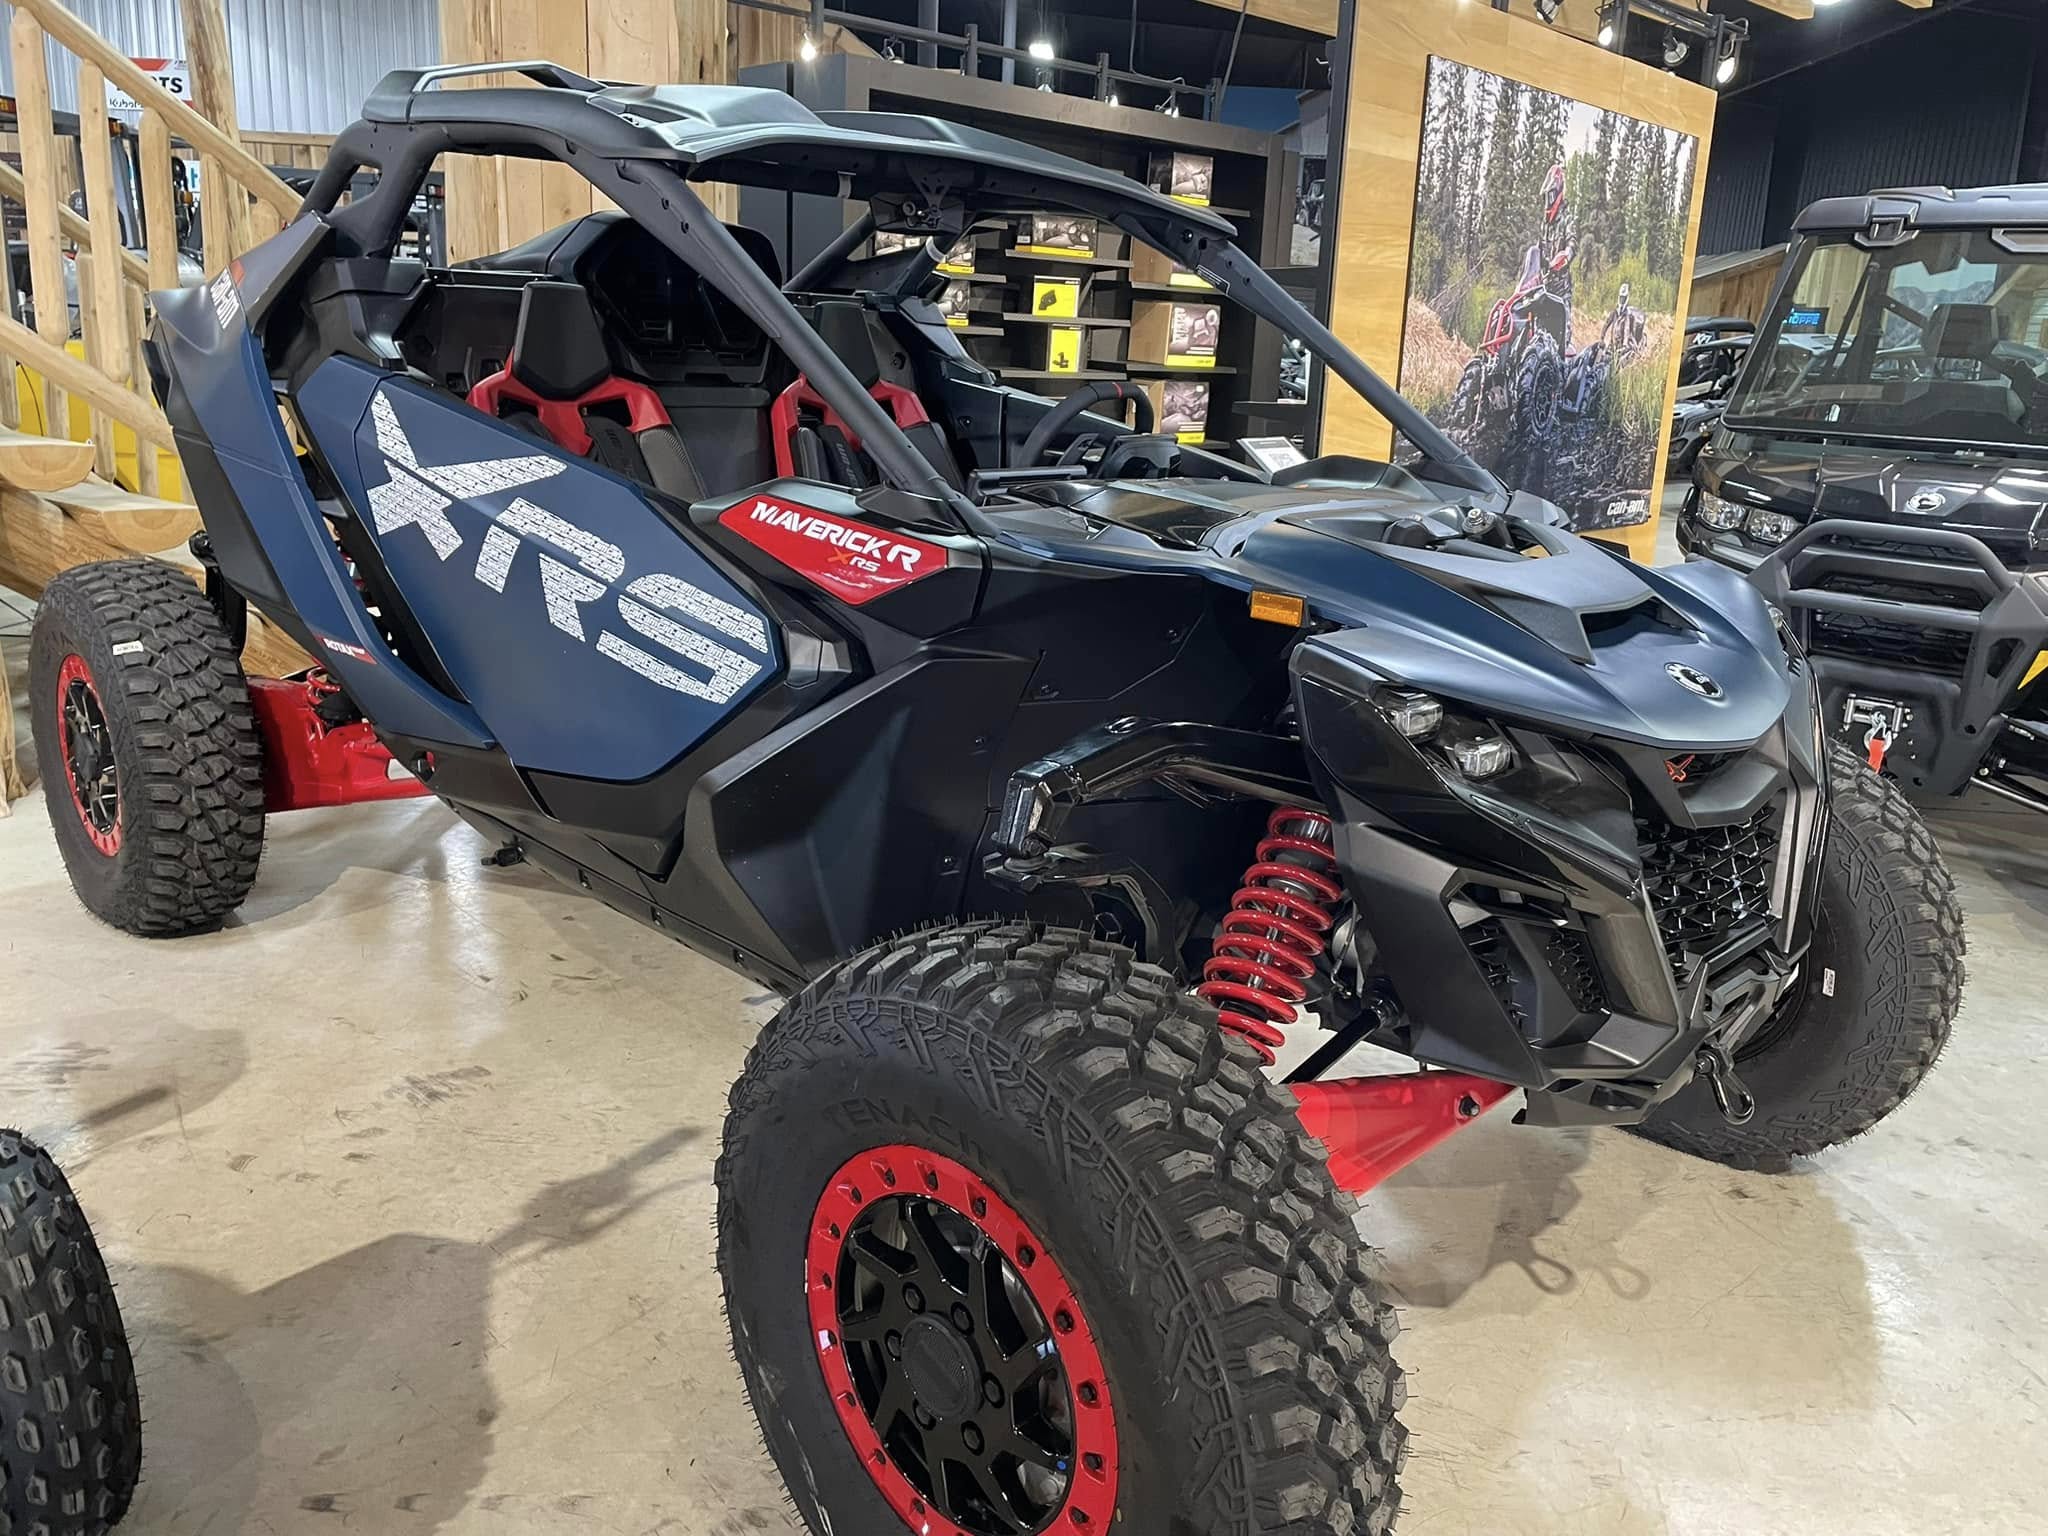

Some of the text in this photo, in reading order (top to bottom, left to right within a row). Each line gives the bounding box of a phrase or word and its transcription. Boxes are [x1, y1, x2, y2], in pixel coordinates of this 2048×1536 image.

[1606, 499, 1645, 516] can-am
[366, 390, 769, 705] XRS
[751, 501, 922, 574] MAVERICK R
[826, 547, 881, 573] XRS
